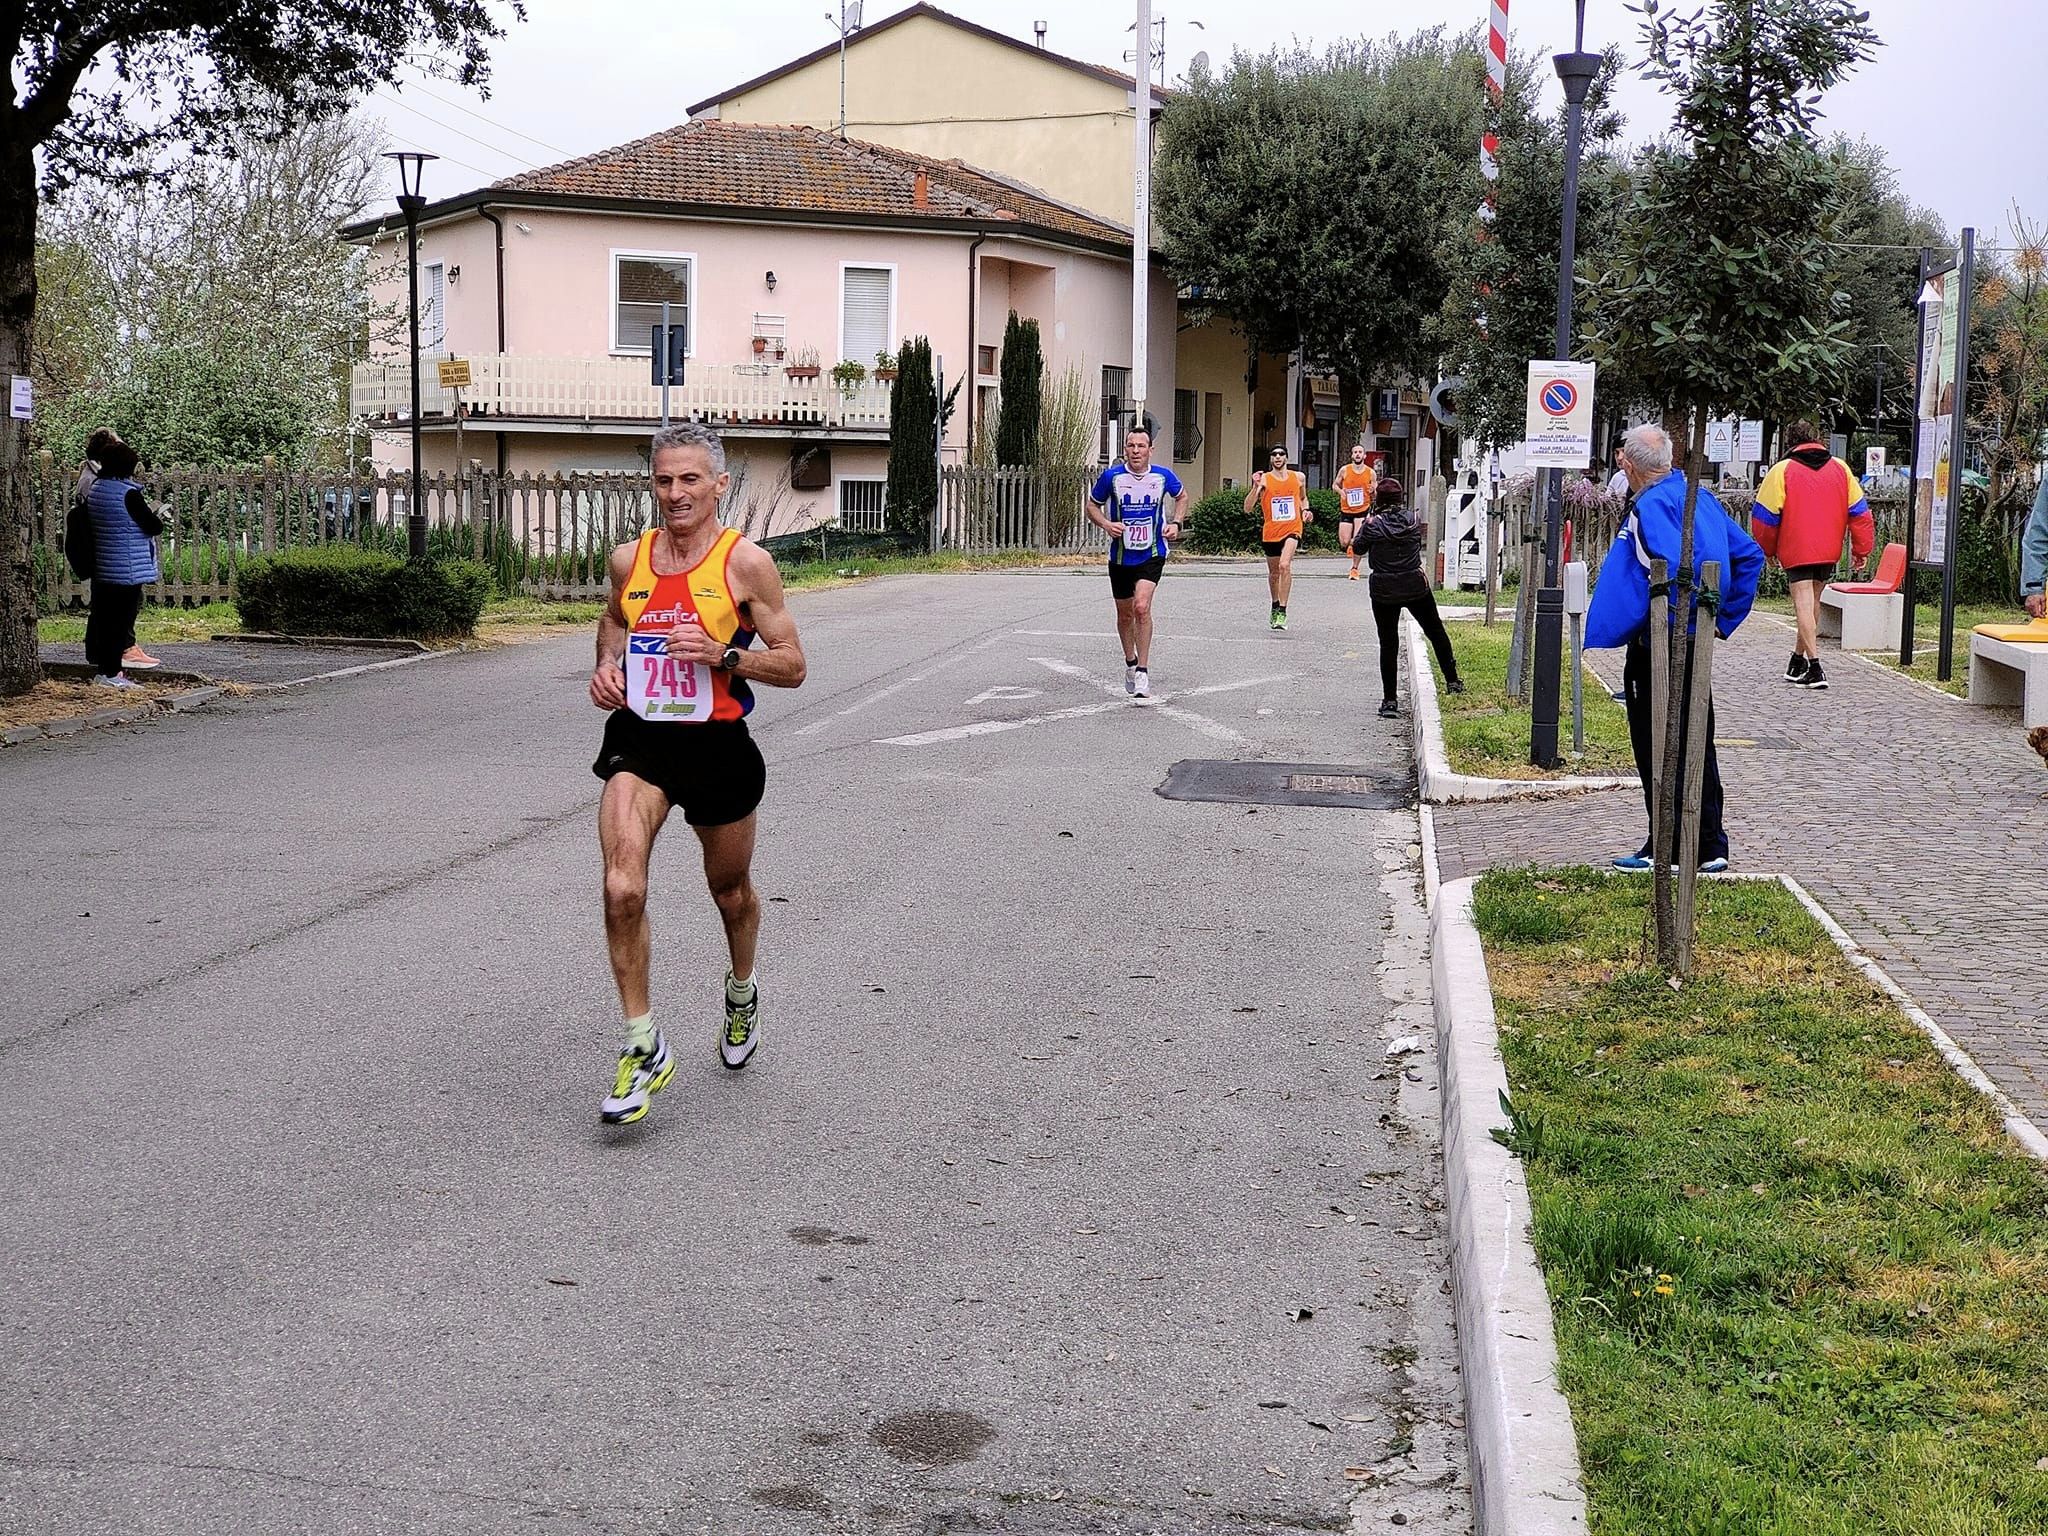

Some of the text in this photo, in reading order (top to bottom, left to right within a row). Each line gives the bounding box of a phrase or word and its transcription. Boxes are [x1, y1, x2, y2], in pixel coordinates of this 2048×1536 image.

[1278, 504, 1288, 515] 48
[1129, 526, 1148, 542] 220
[644, 657, 697, 698] 243
